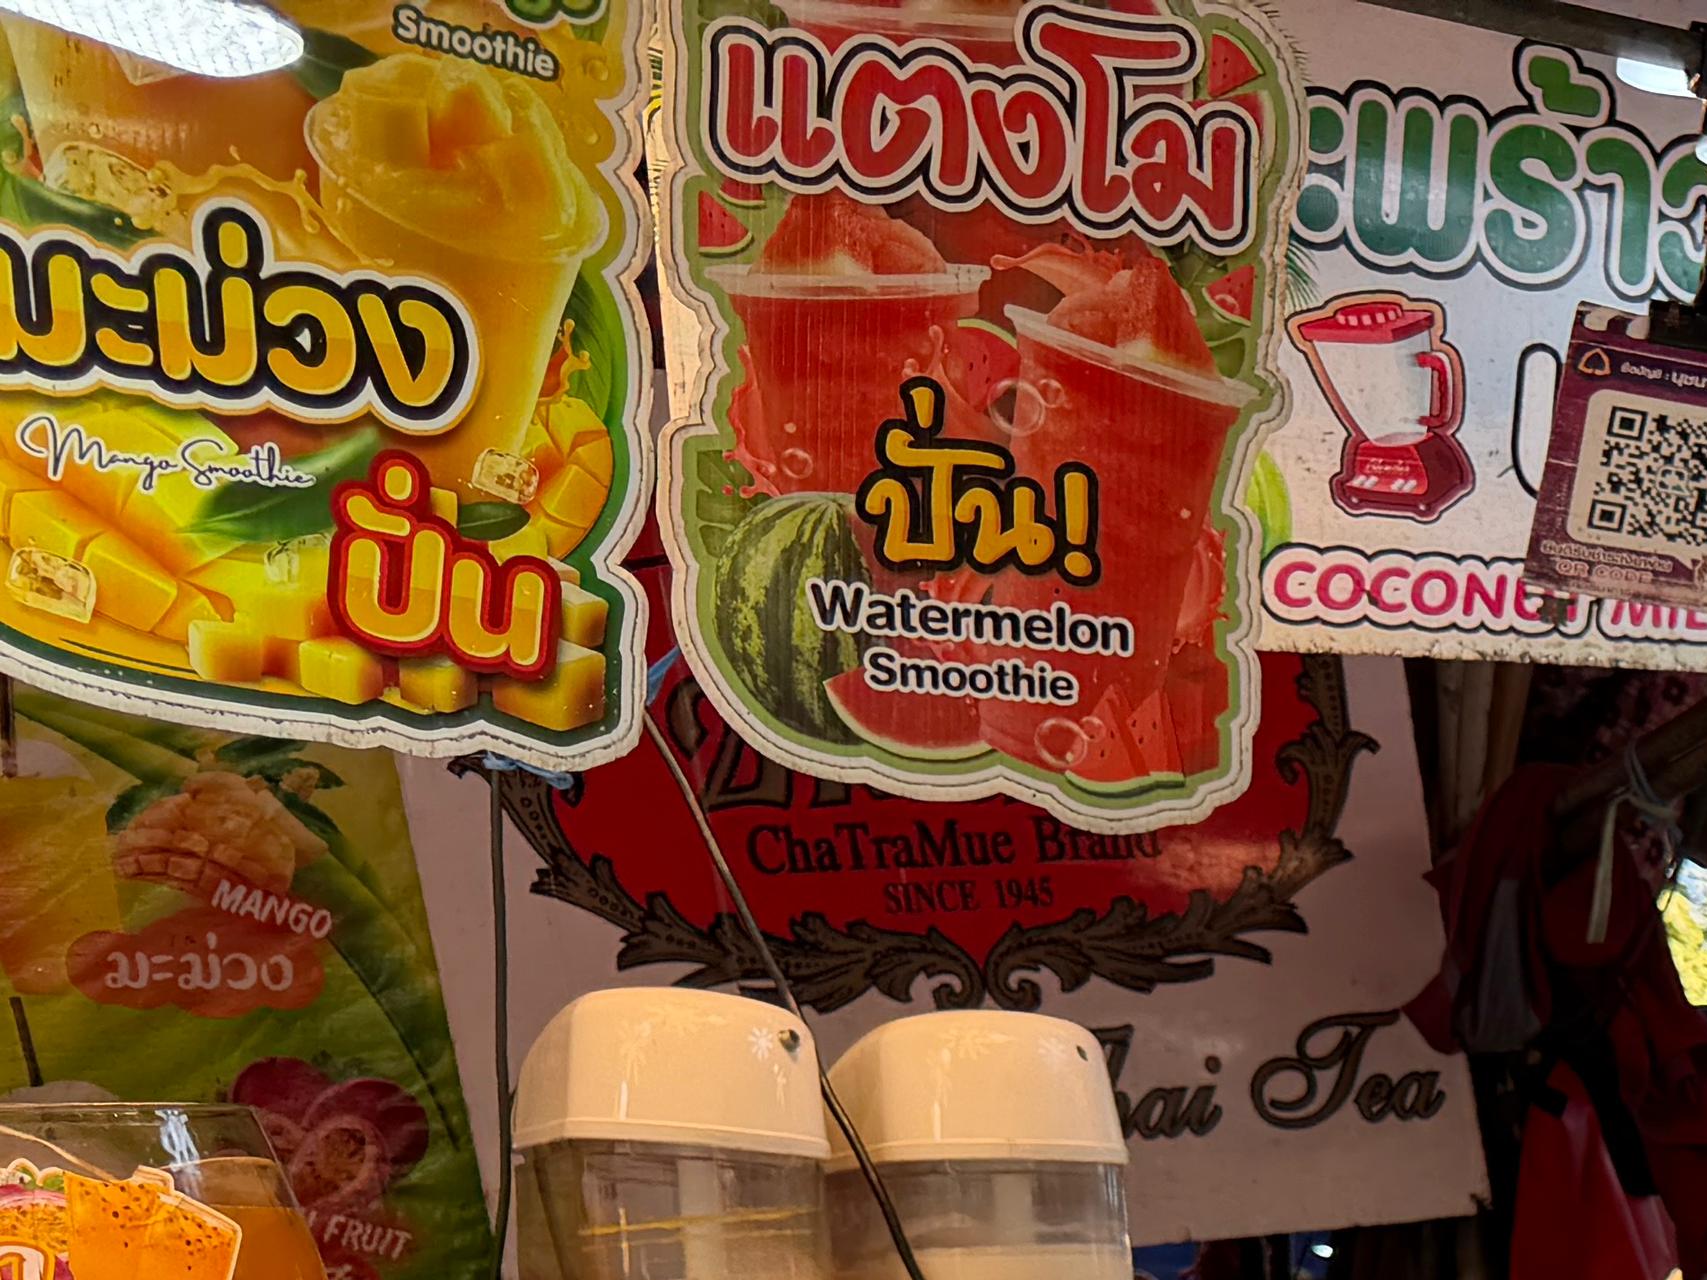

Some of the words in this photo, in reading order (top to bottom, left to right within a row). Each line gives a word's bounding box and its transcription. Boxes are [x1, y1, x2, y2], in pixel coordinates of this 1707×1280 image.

[396, 9, 556, 78] Smoothie
[722, 18, 1245, 233] แตงโม
[20, 415, 178, 490] Mango
[181, 438, 314, 487] Smoothie
[865, 387, 1097, 576] ปั่น!
[346, 463, 548, 666] ปั่น
[811, 581, 1131, 653] Watermelon
[868, 651, 1075, 701] Smoothie
[746, 819, 1016, 876] ChaTraMue
[210, 878, 333, 939] MANGO
[884, 878, 978, 914] SINCE
[995, 876, 1054, 908] 1945
[1249, 1008, 1447, 1131] Tea
[324, 1215, 413, 1259] FRUIT
